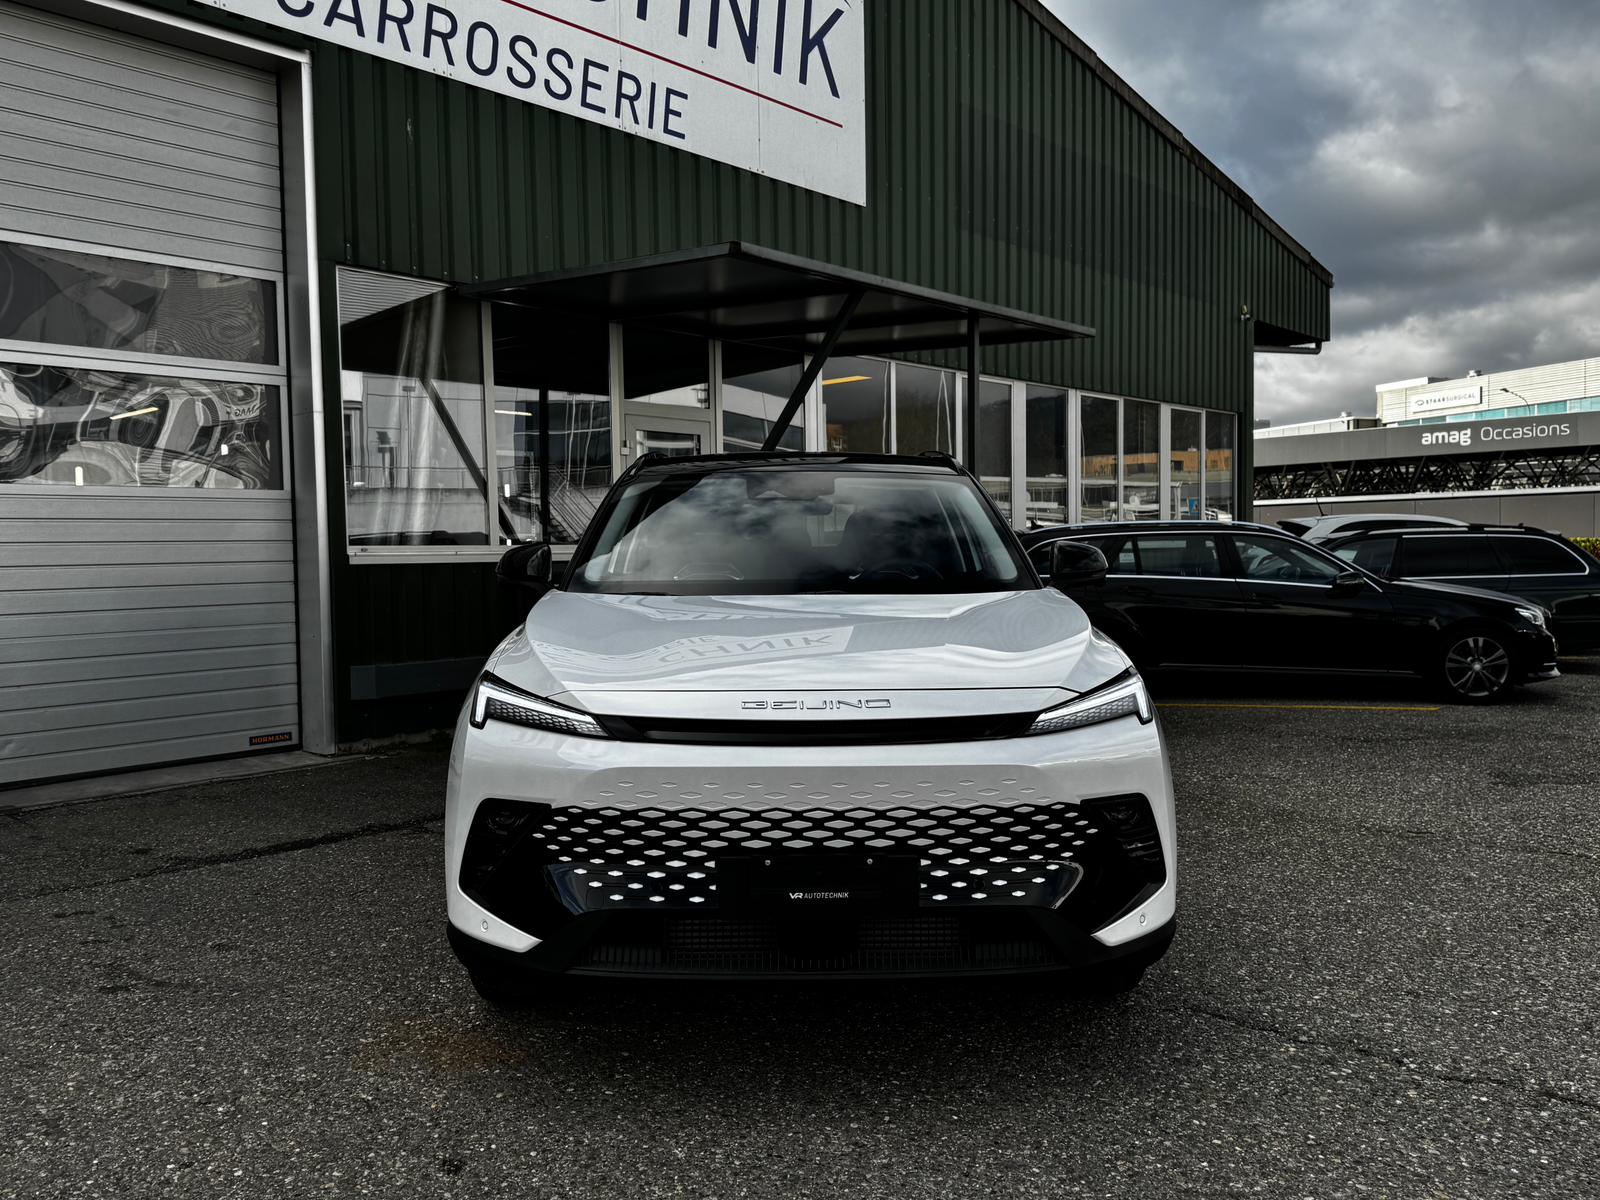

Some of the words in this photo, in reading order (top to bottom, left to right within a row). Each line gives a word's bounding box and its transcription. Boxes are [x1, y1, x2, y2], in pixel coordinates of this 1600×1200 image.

[588, 0, 844, 99] NIK
[1421, 428, 1471, 446] amag
[1480, 423, 1570, 441] Occasions
